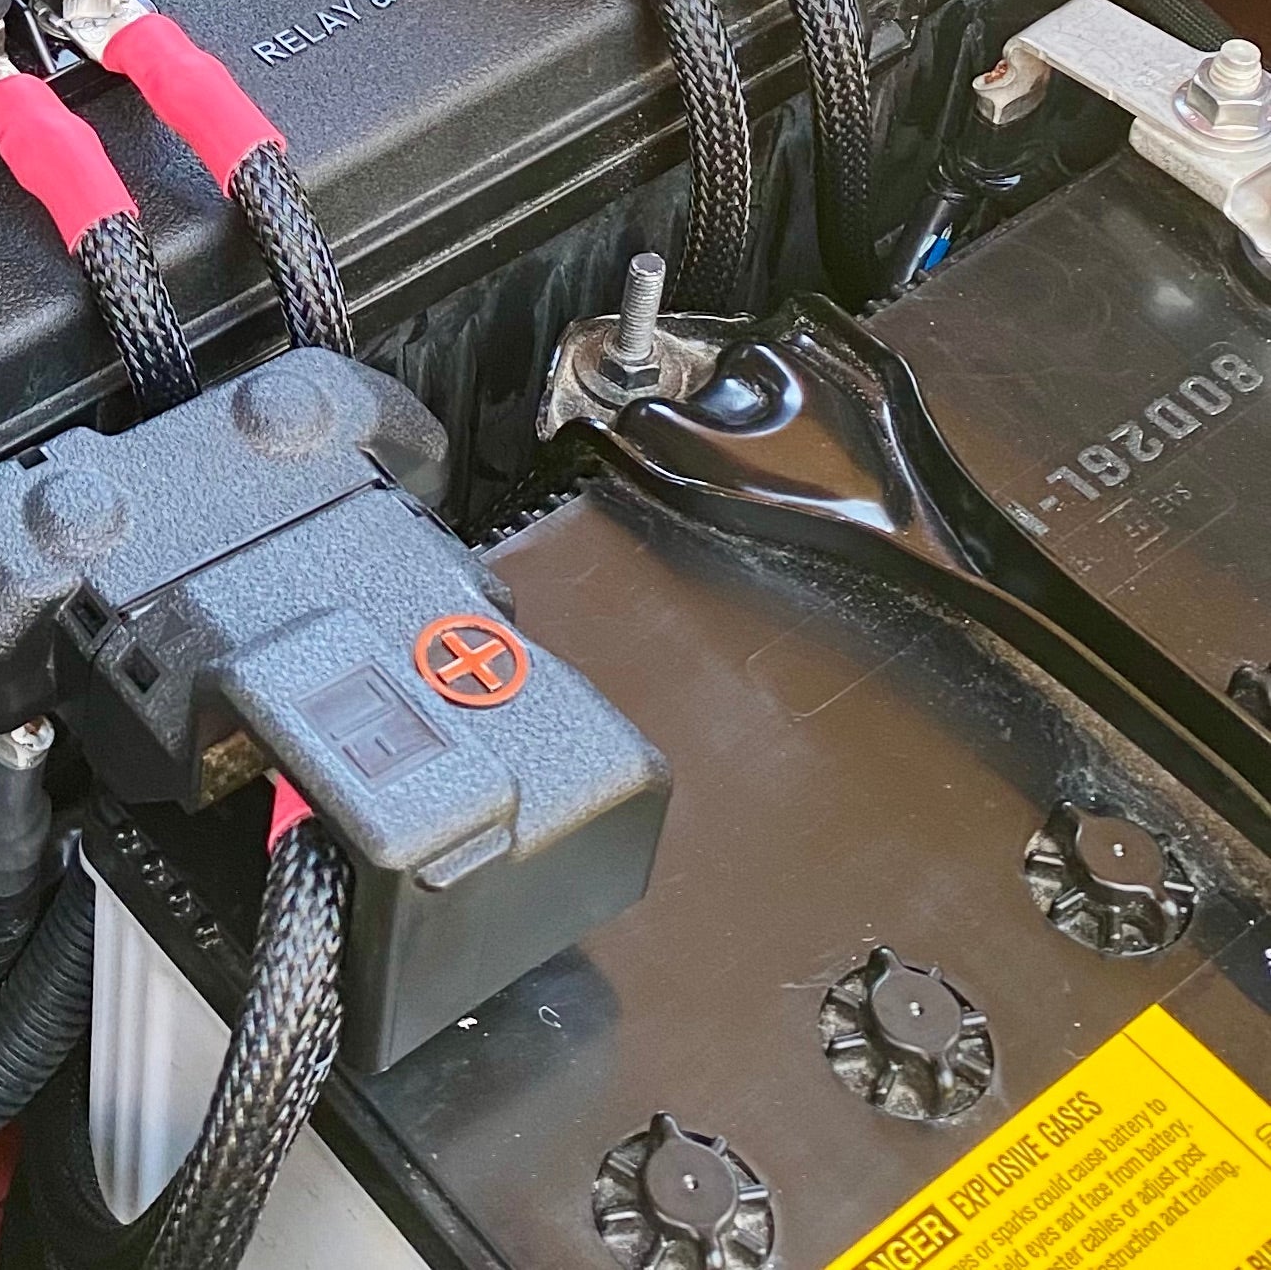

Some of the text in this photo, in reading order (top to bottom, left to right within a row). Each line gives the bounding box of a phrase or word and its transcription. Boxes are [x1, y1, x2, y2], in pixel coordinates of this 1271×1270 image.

[947, 1133, 1050, 1221] EXPLOSIVE
[1037, 1091, 1103, 1148] GASES
[974, 1098, 1168, 1261] or sparks could cause battery to
[1025, 1226, 1062, 1258] eyes
[1056, 1202, 1087, 1232] and
[1078, 1182, 1114, 1211] face
[1106, 1156, 1145, 1188] from
[1134, 1118, 1193, 1163] battery.
[1081, 1213, 1126, 1253] cables
[1120, 1198, 1140, 1218] or
[1136, 1165, 1180, 1206] adjust
[1173, 1142, 1208, 1178] post
[1159, 1195, 1190, 1227] and
[1180, 1159, 1241, 1207] training.
